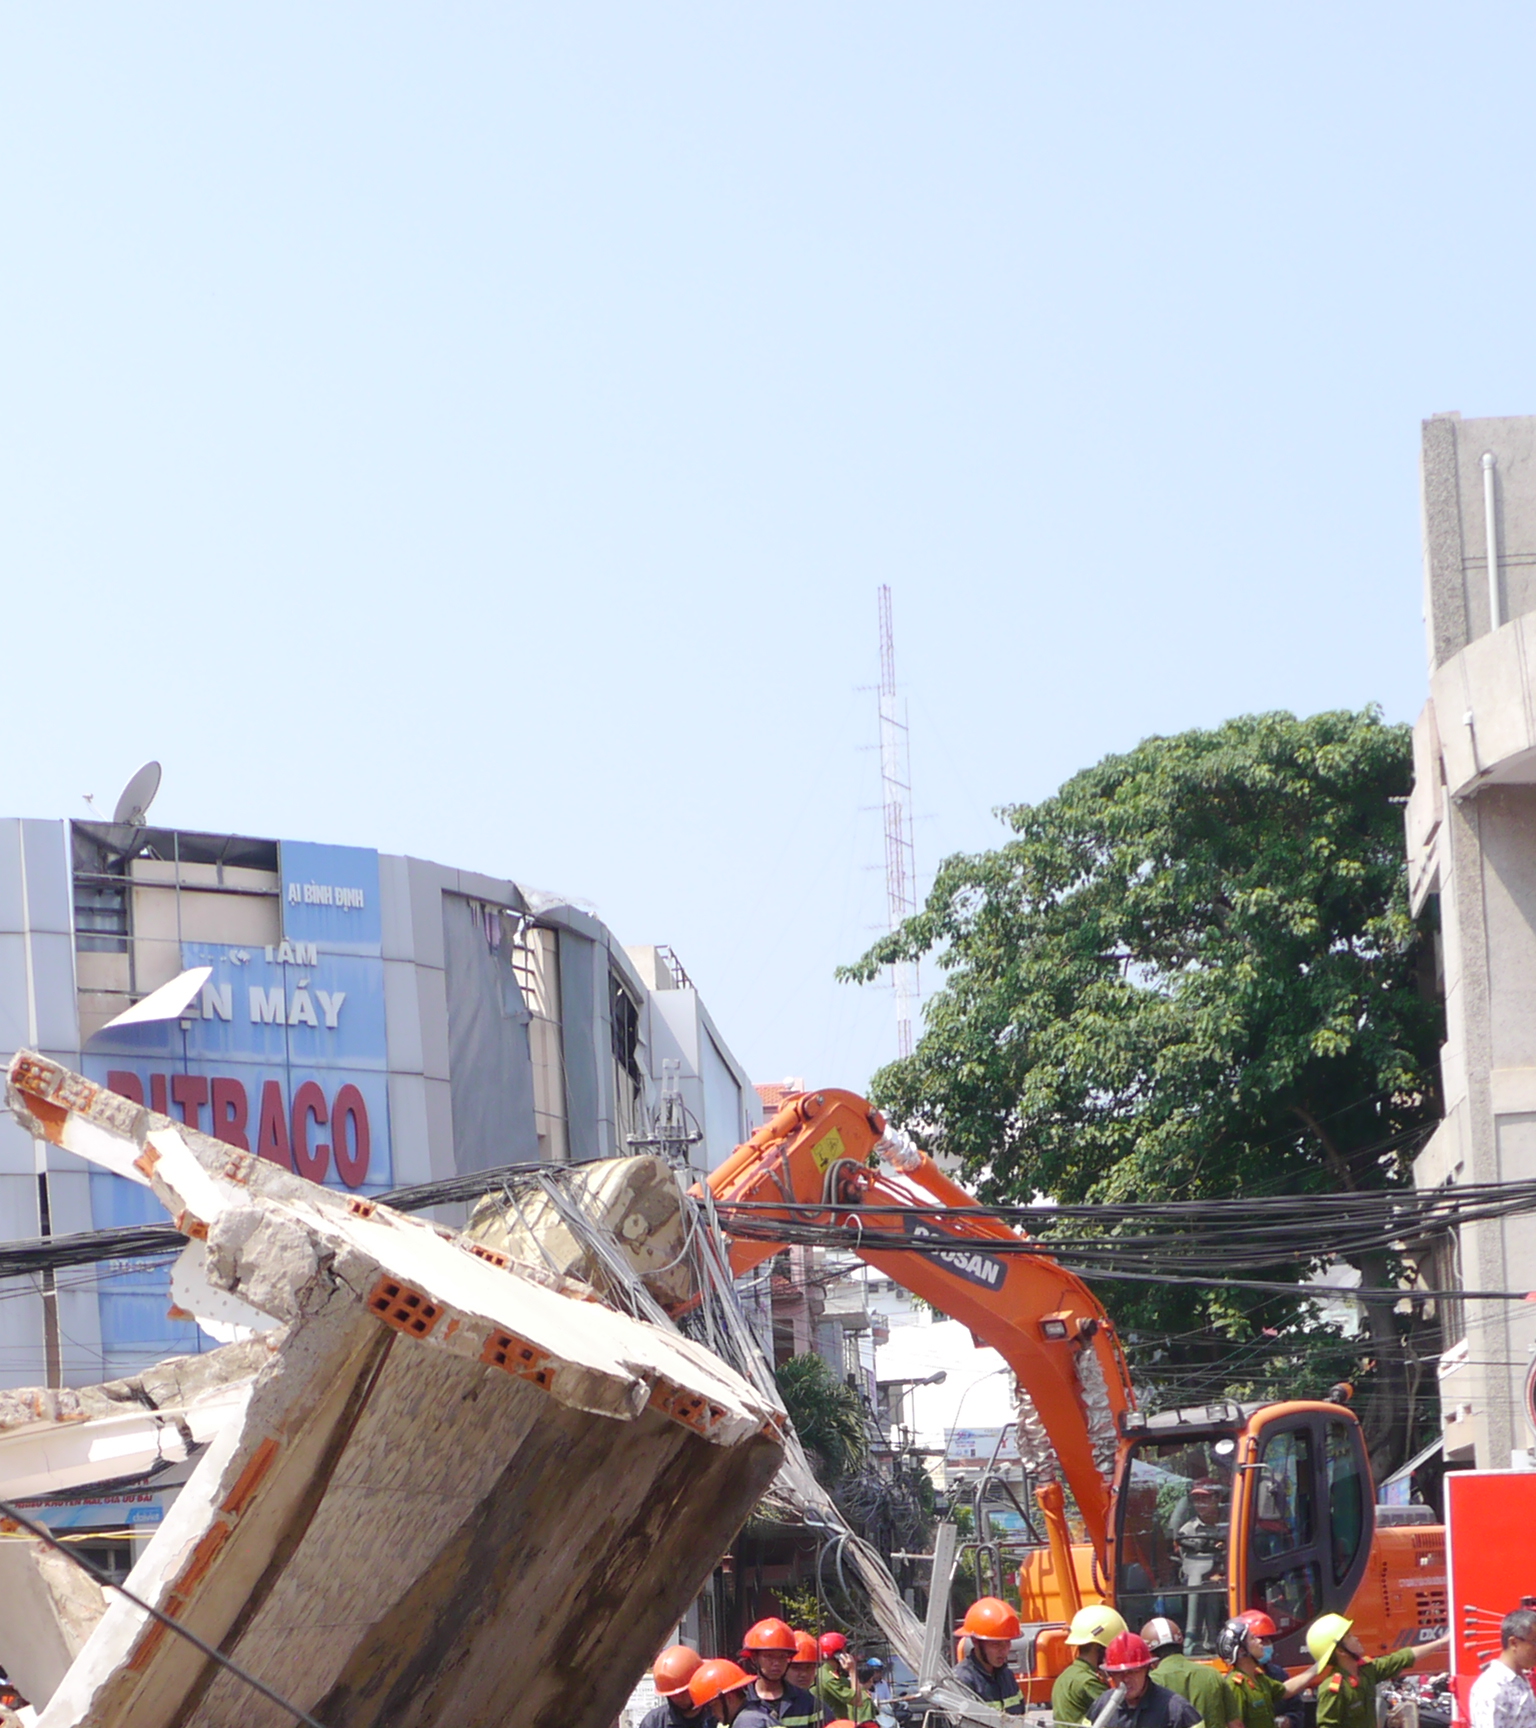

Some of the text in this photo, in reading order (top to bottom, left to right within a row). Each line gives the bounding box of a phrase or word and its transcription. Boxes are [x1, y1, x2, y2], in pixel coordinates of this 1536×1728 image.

[304, 880, 333, 905] BÌNH
[335, 887, 363, 912] ĐỊNH
[249, 979, 346, 1029] MÁY
